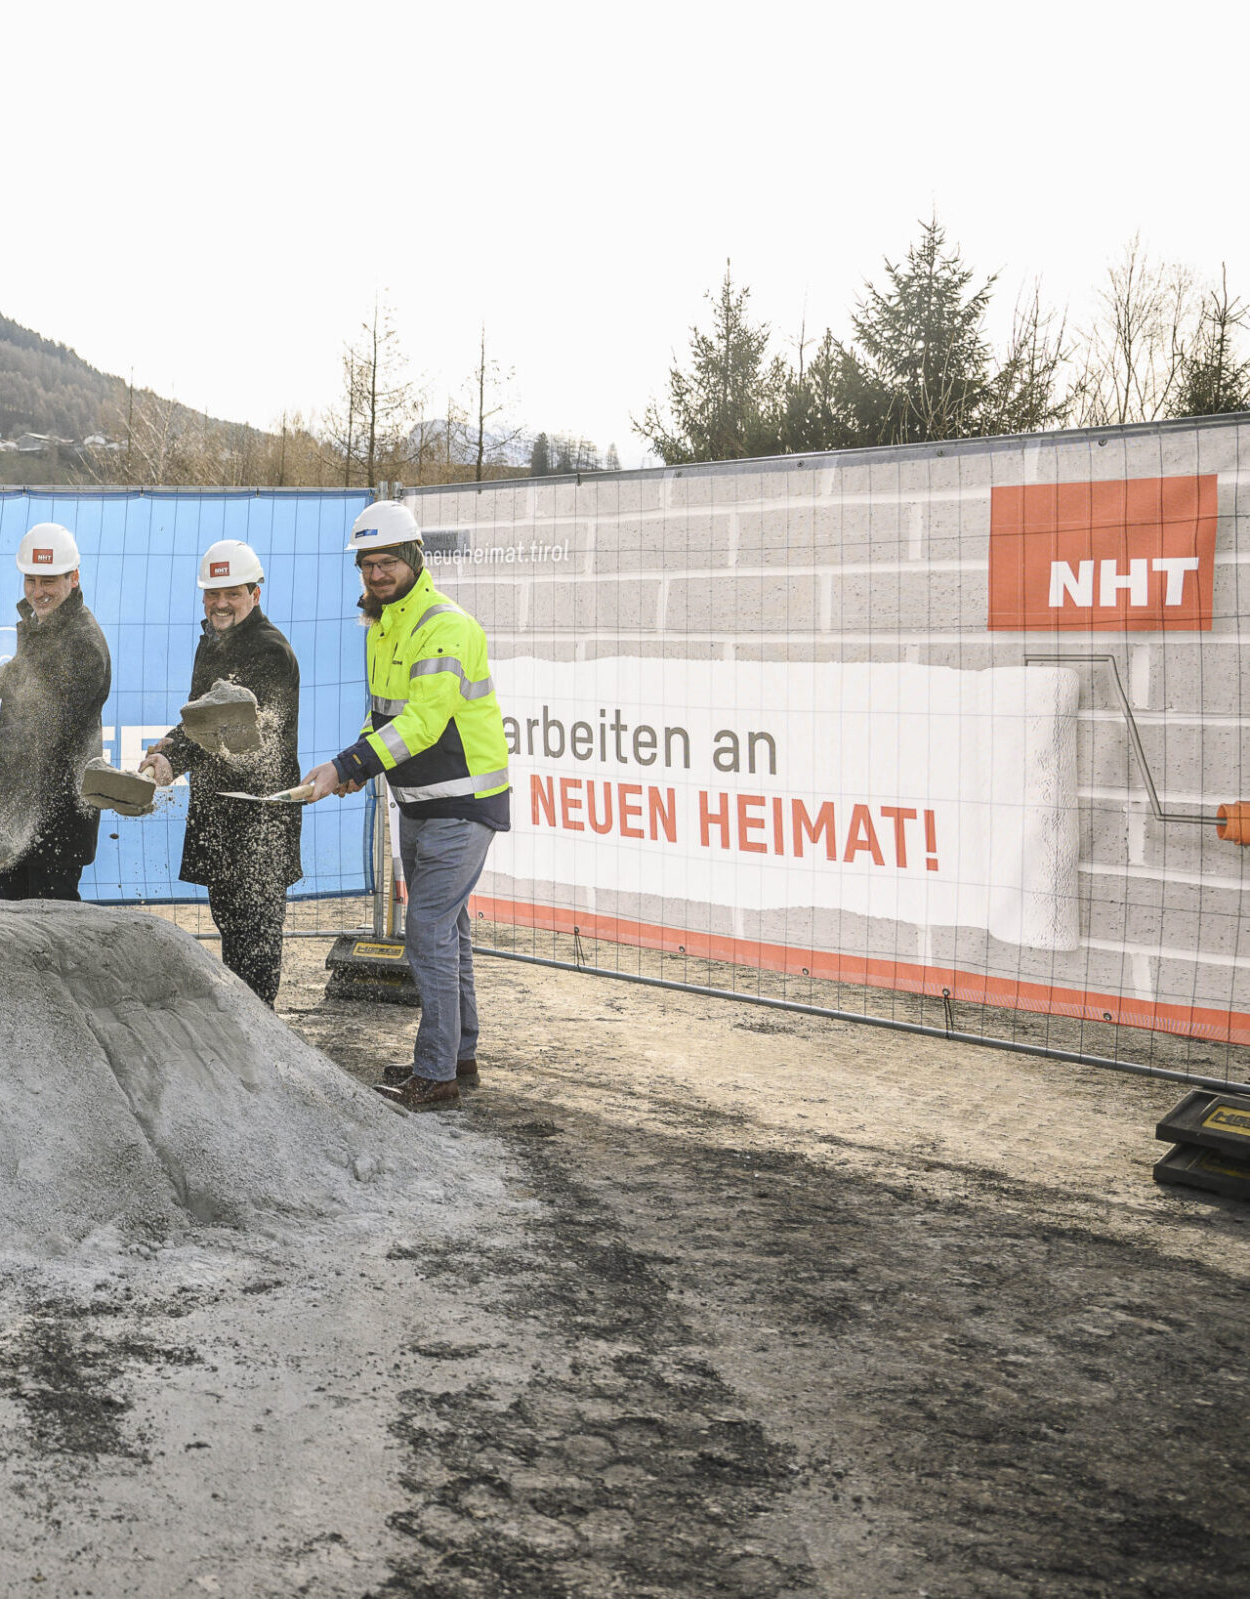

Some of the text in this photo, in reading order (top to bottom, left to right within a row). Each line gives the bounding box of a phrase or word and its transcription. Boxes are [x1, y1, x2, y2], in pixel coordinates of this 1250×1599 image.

[424, 539, 570, 567] neueheimat.tirol
[1049, 557, 1200, 608] NHT
[506, 705, 777, 776] arbeiten an
[530, 774, 939, 871] NEUEN HEIMAT!
